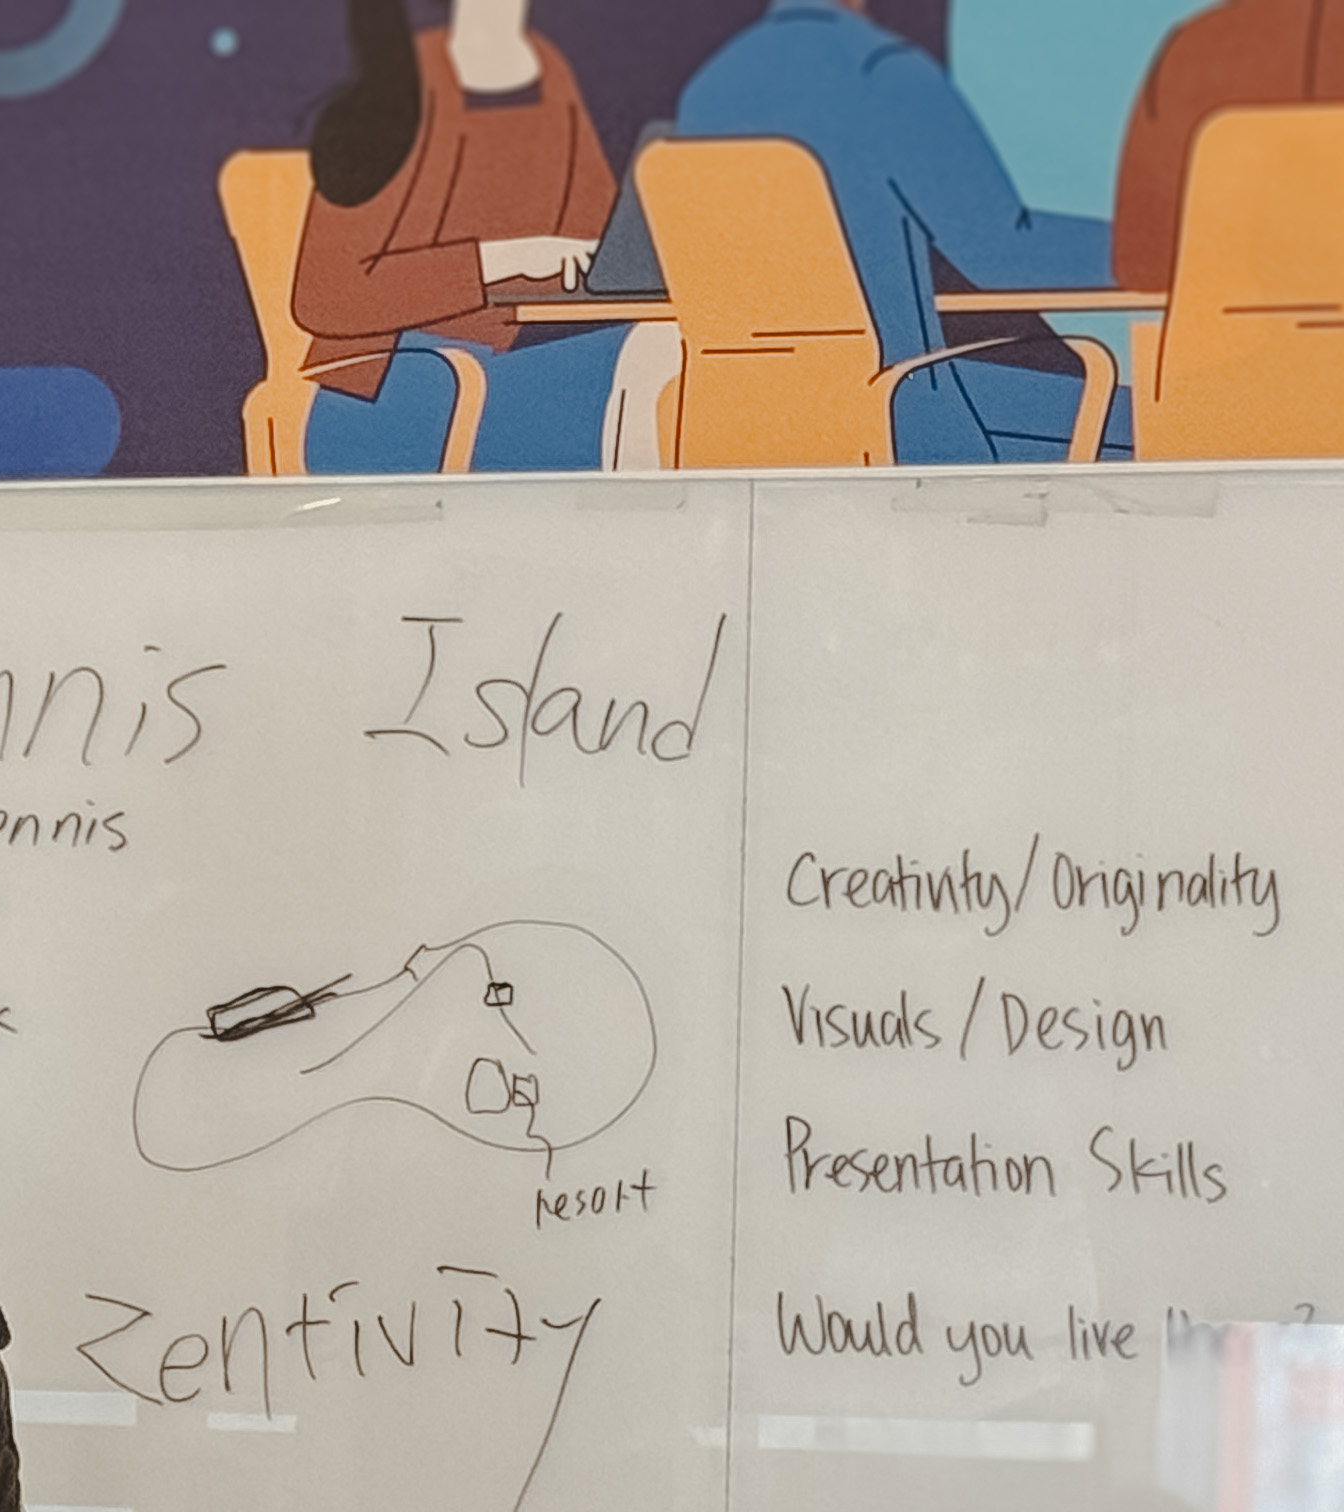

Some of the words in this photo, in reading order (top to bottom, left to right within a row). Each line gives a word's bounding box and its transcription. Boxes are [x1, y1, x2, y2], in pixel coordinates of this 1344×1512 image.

[364, 613, 726, 787] Island
[535, 1169, 656, 1228] resort
[786, 1115, 1056, 1197] Presentation
[1088, 1125, 1228, 1203] Skills
[777, 1292, 924, 1357] Would
[946, 1317, 1035, 1387] you
[1068, 1303, 1140, 1361] live
